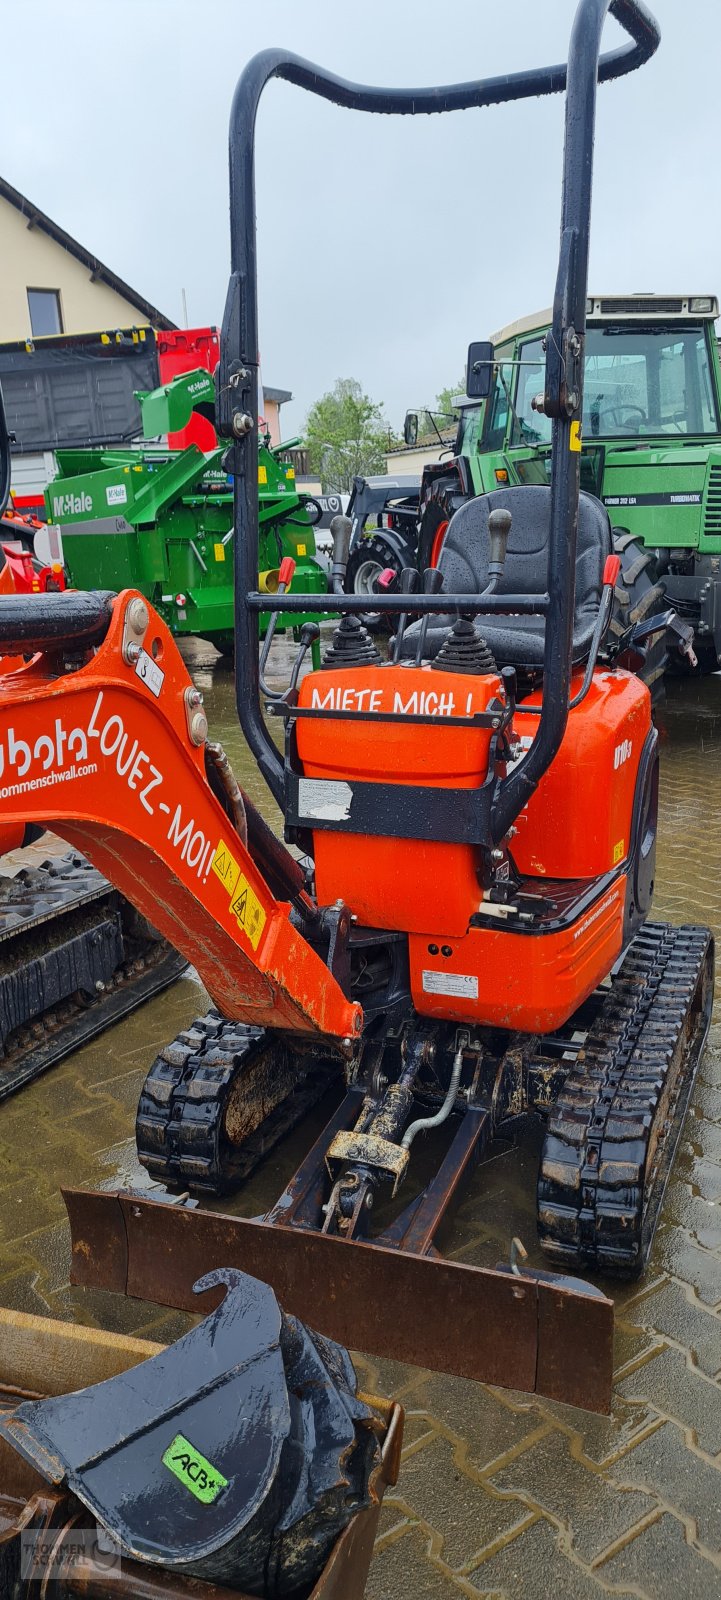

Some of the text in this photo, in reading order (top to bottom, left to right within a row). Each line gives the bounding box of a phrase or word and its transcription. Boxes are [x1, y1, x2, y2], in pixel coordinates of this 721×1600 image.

[53, 491, 93, 517] McHale
[311, 688, 383, 713] MIETE
[393, 691, 456, 716] MICH
[0, 763, 98, 798] ommenschwall.com
